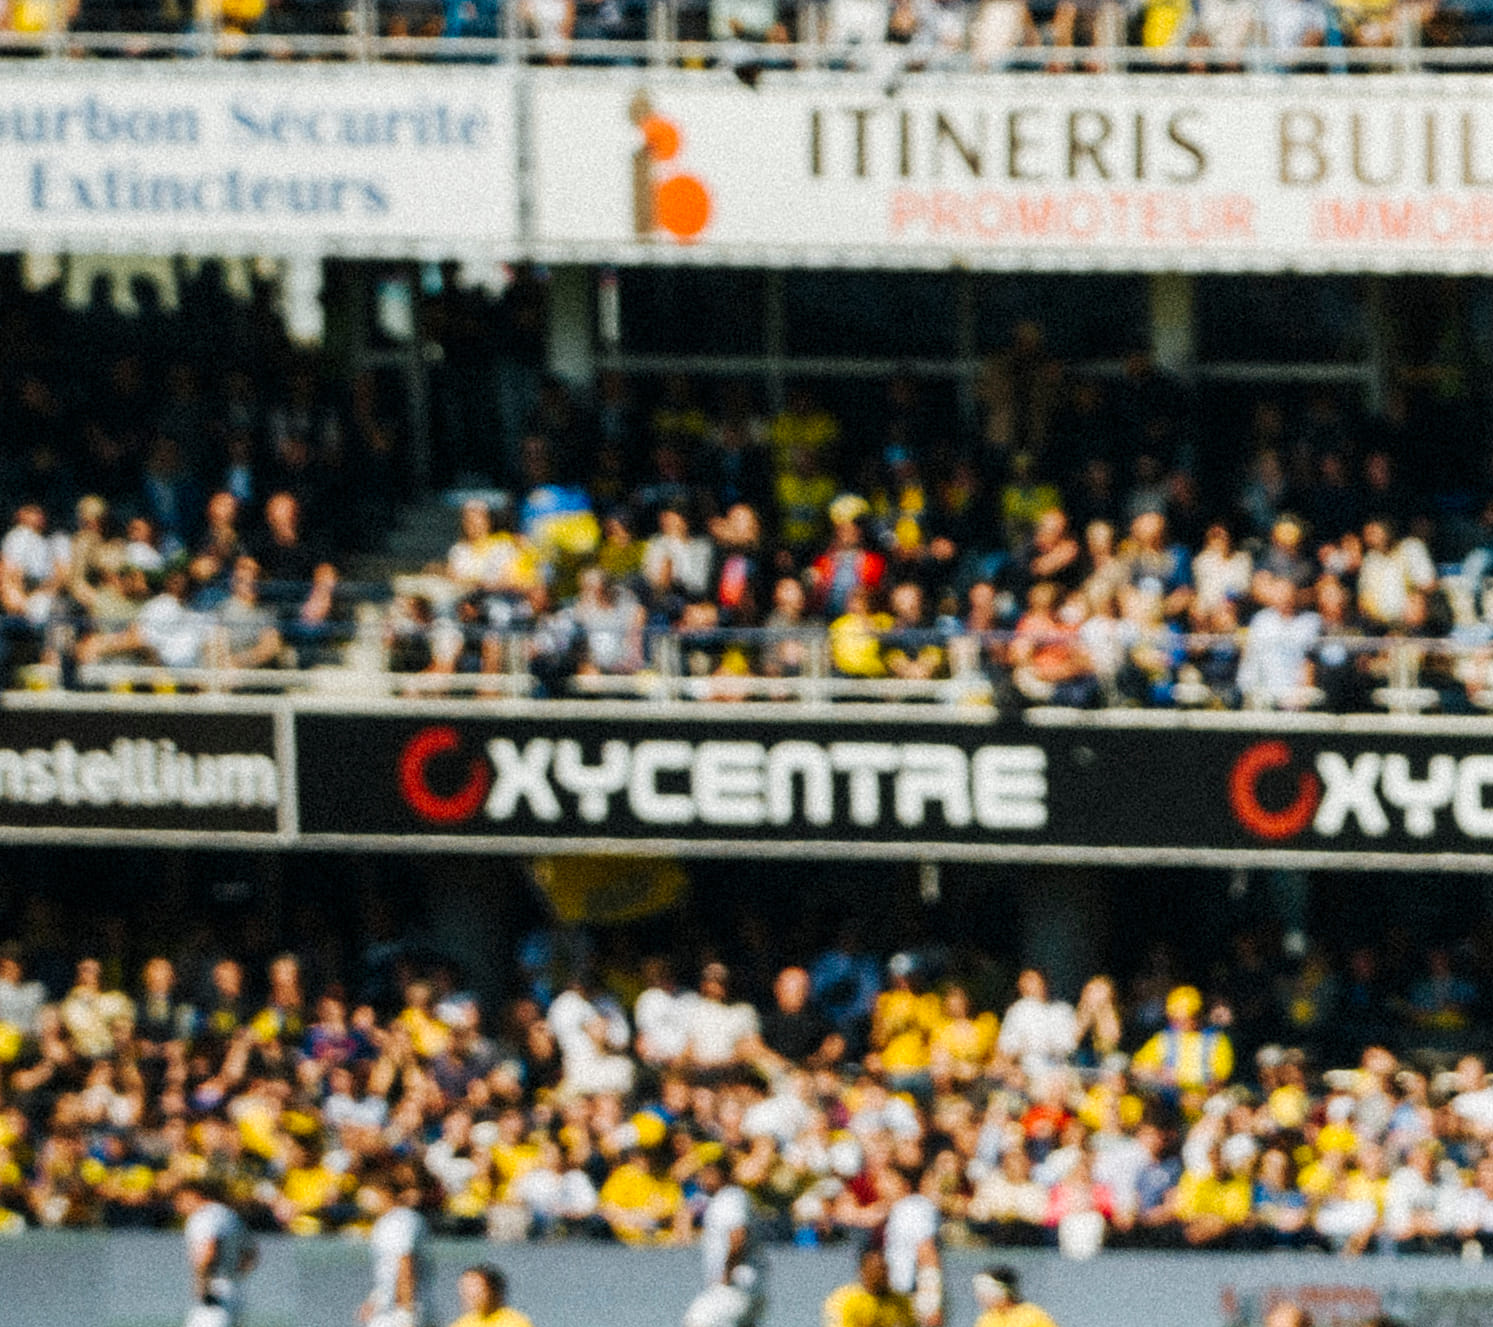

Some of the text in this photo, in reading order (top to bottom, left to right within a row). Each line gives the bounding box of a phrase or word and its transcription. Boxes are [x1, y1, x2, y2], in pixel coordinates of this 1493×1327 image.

[808, 106, 1209, 186] ITINERIS
[28, 160, 392, 213] Extincteurs
[890, 191, 1259, 244] PROMOTEUR
[399, 725, 1048, 830] OXYCENTRE
